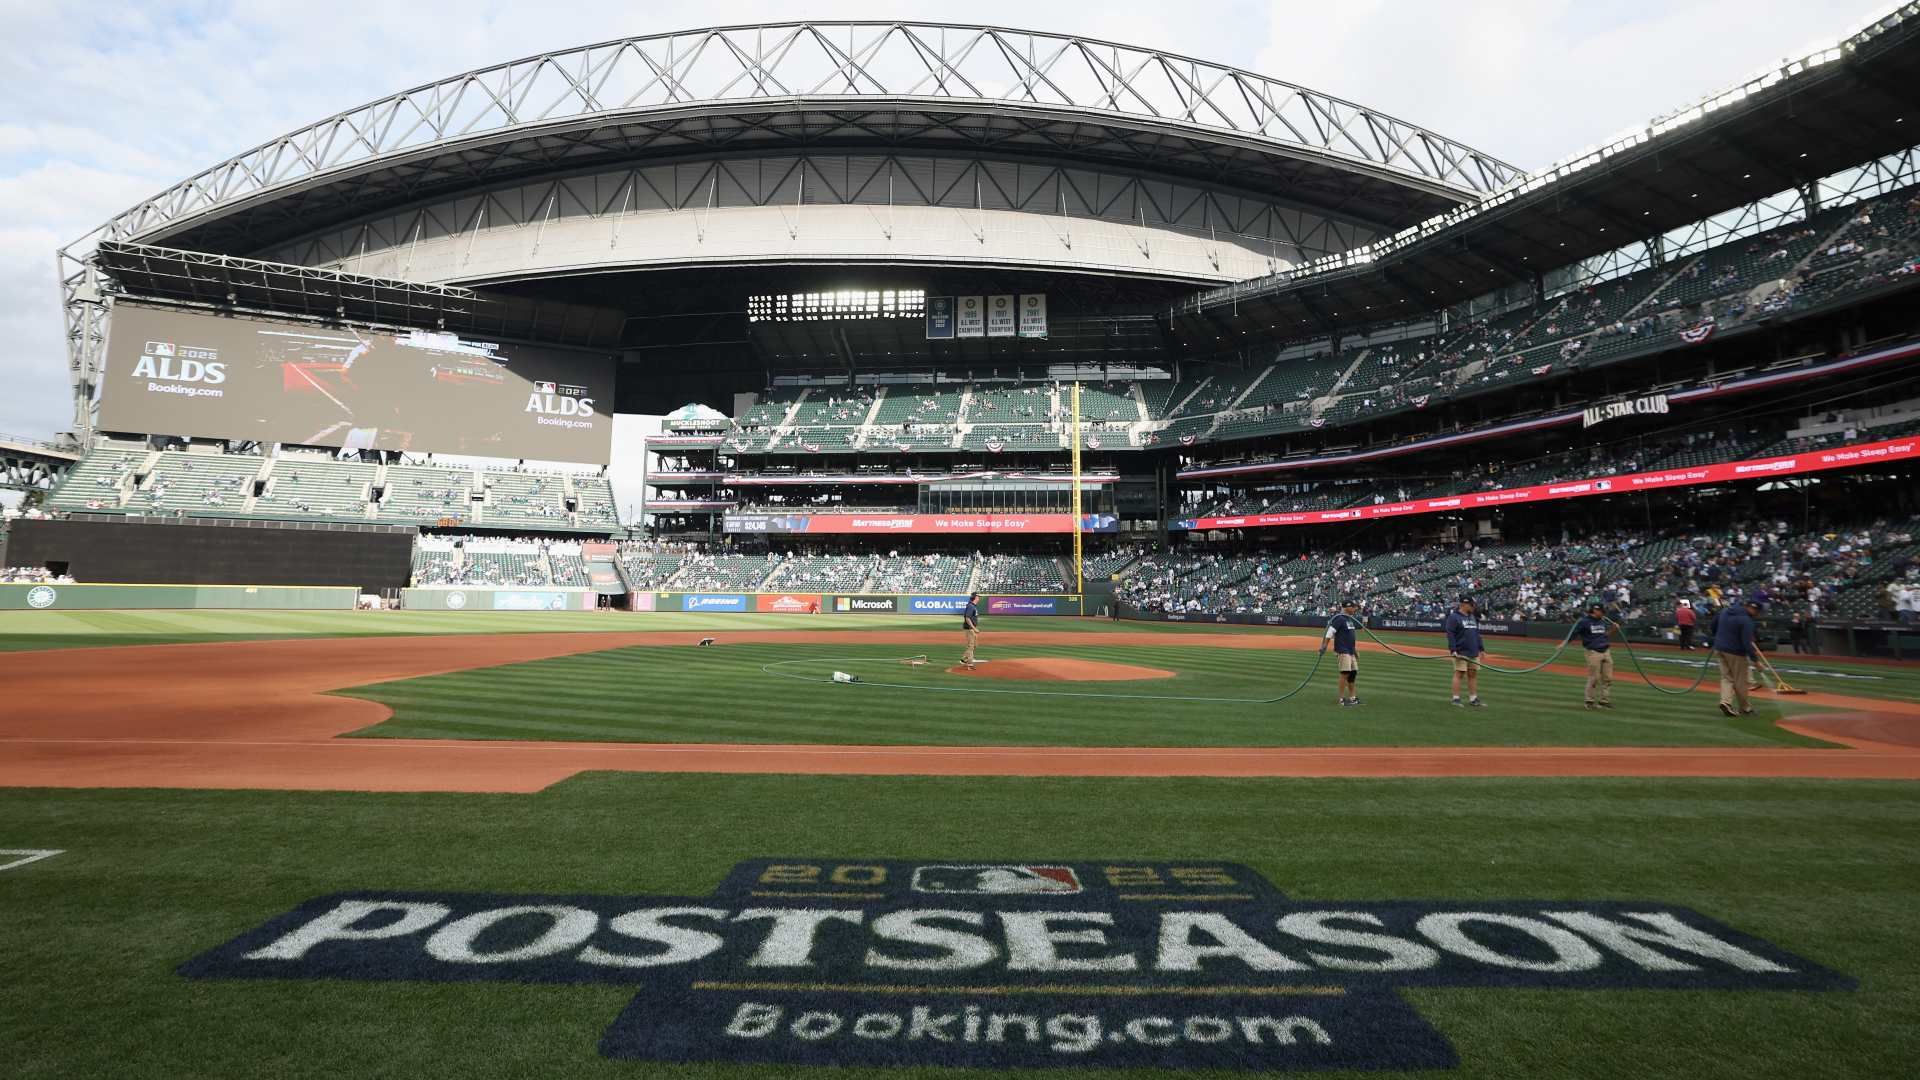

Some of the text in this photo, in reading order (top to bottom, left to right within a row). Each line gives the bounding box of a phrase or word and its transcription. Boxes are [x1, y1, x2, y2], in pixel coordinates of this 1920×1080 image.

[178, 349, 217, 360] 2025
[131, 355, 226, 384] ALDS
[147, 382, 224, 397] Booking.com
[558, 388, 588, 396] 2025
[525, 393, 594, 417] ALDS
[1636, 394, 1670, 414] CLUB
[537, 416, 593, 429] Booking.com
[1822, 454, 1836, 462] We
[1837, 452, 1859, 460] Make
[1860, 448, 1888, 458] Sleep
[1645, 476, 1663, 484] Make
[1664, 474, 1686, 482] Sleep
[976, 520, 1002, 528] Sleep
[851, 599, 893, 609] Microsoft
[914, 600, 954, 609] GLOBAL
[759, 863, 1238, 887] 20 25
[241, 899, 1797, 975] POSTSEASON
[724, 1001, 1333, 1053] Booking.com
